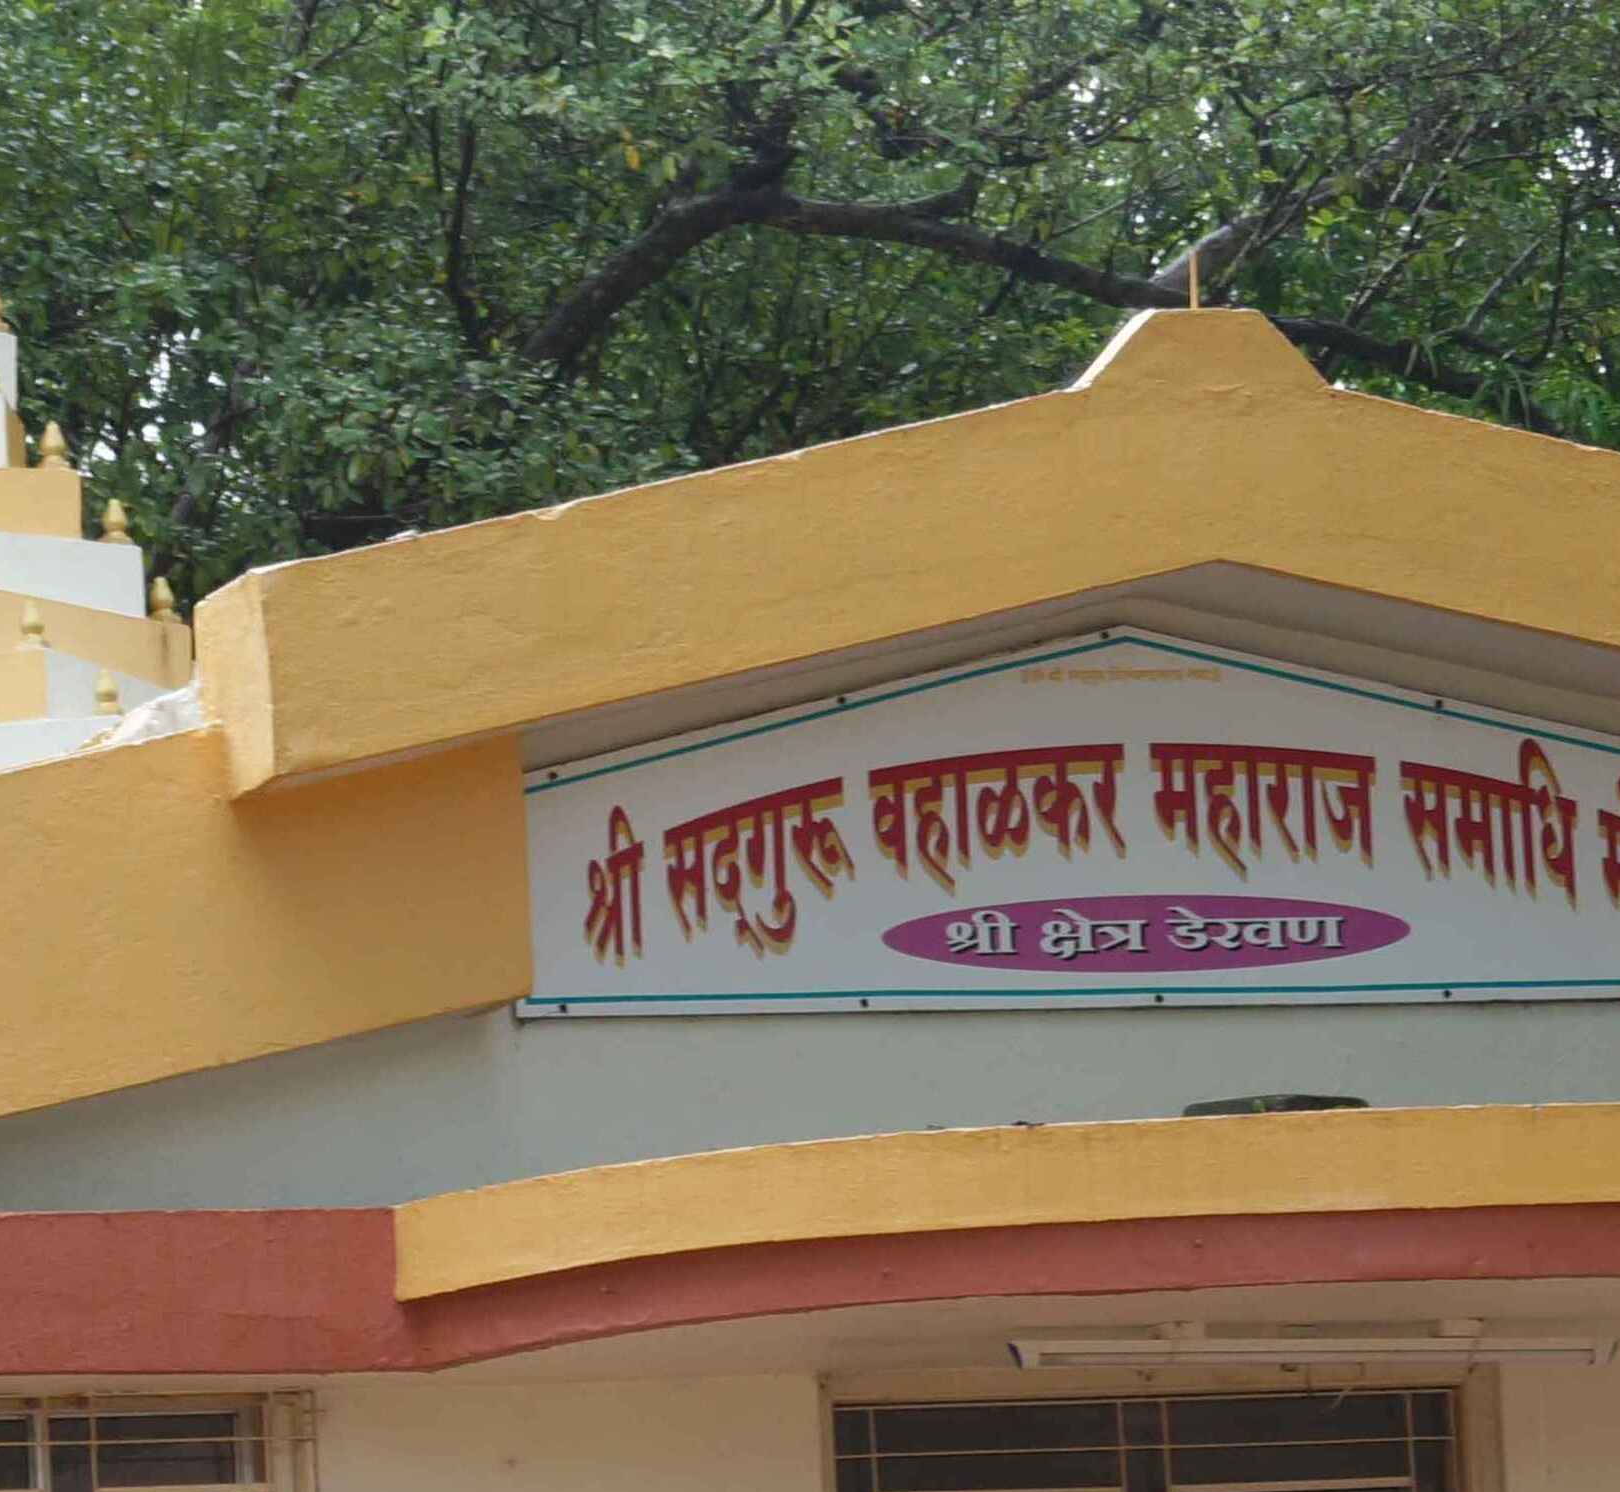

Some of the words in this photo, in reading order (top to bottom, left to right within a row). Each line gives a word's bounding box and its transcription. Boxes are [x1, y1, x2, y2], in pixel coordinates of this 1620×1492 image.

[585, 805, 644, 968] श्री
[868, 743, 1126, 896] वहाळकर
[1150, 743, 1376, 882] महाराज
[1399, 738, 1578, 912] समाधि
[945, 909, 1018, 956] श्री
[1040, 907, 1149, 960] क्षेत्र
[1165, 906, 1344, 951] डेरवण
